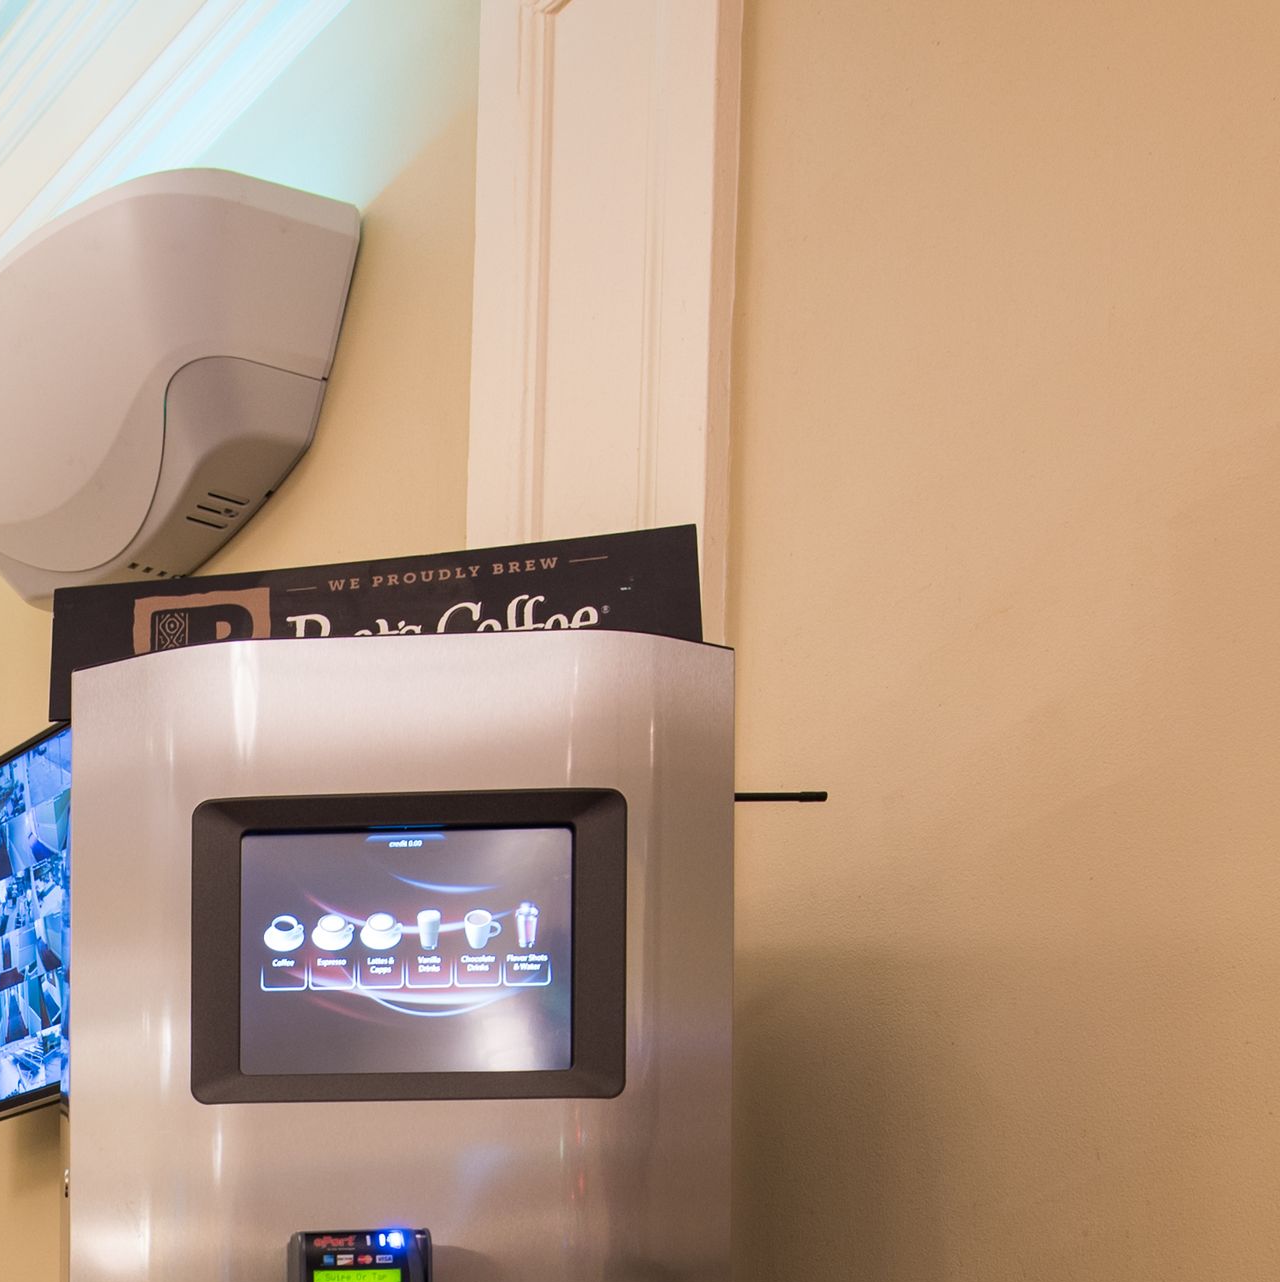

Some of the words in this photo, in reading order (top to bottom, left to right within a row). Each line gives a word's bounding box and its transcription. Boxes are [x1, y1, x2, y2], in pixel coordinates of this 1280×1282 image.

[328, 577, 360, 592] WE
[372, 565, 481, 588] PROUDLY
[492, 556, 559, 576] BREW
[272, 958, 295, 967] Coffee
[317, 957, 348, 968] Espresso
